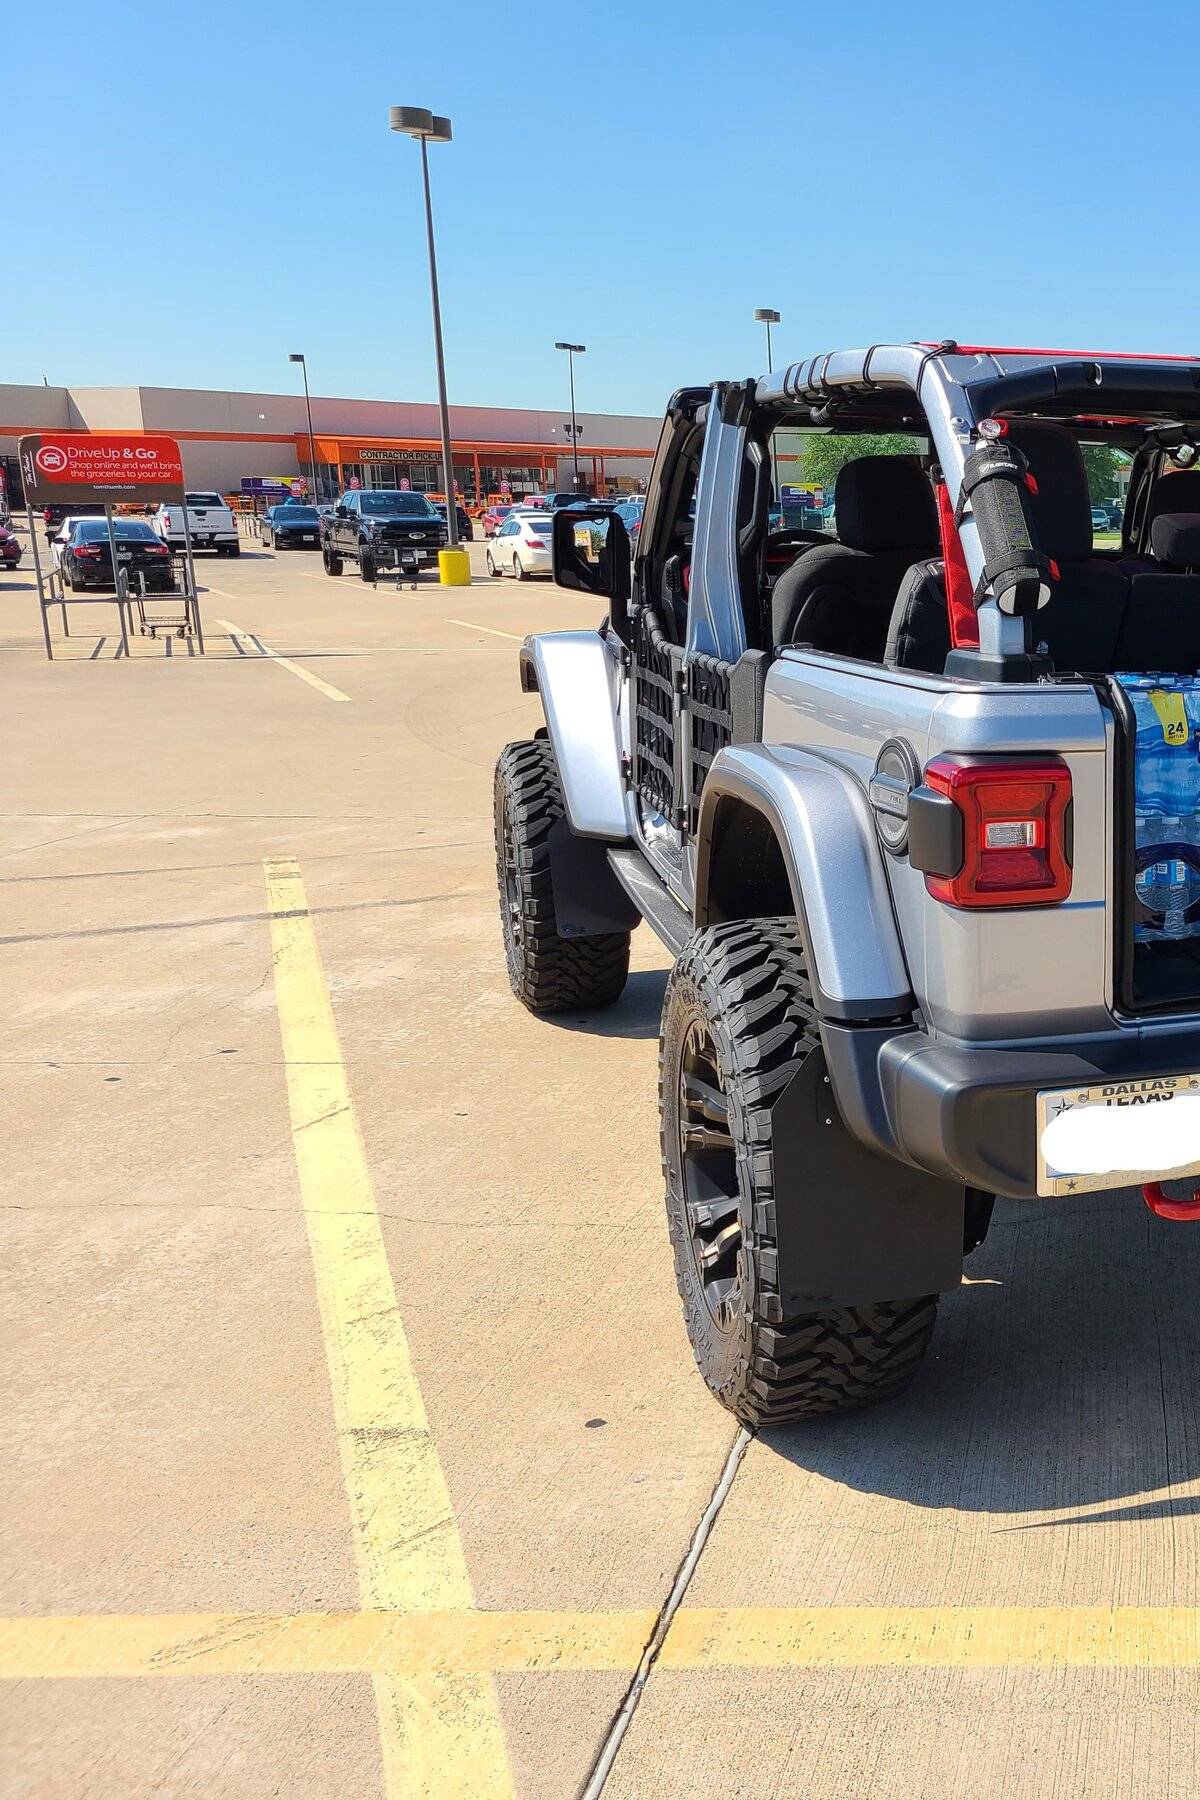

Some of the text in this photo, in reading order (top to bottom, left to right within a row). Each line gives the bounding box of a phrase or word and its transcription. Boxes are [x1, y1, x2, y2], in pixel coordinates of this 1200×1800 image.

[67, 447, 157, 460] DriveUp & Go
[360, 451, 414, 460] CONTRACTOR
[69, 461, 181, 471] Shop online and we'll bring
[71, 470, 174, 479] the groceries to your car.
[1167, 721, 1185, 735] 24
[1102, 1079, 1177, 1097] DALLAS
